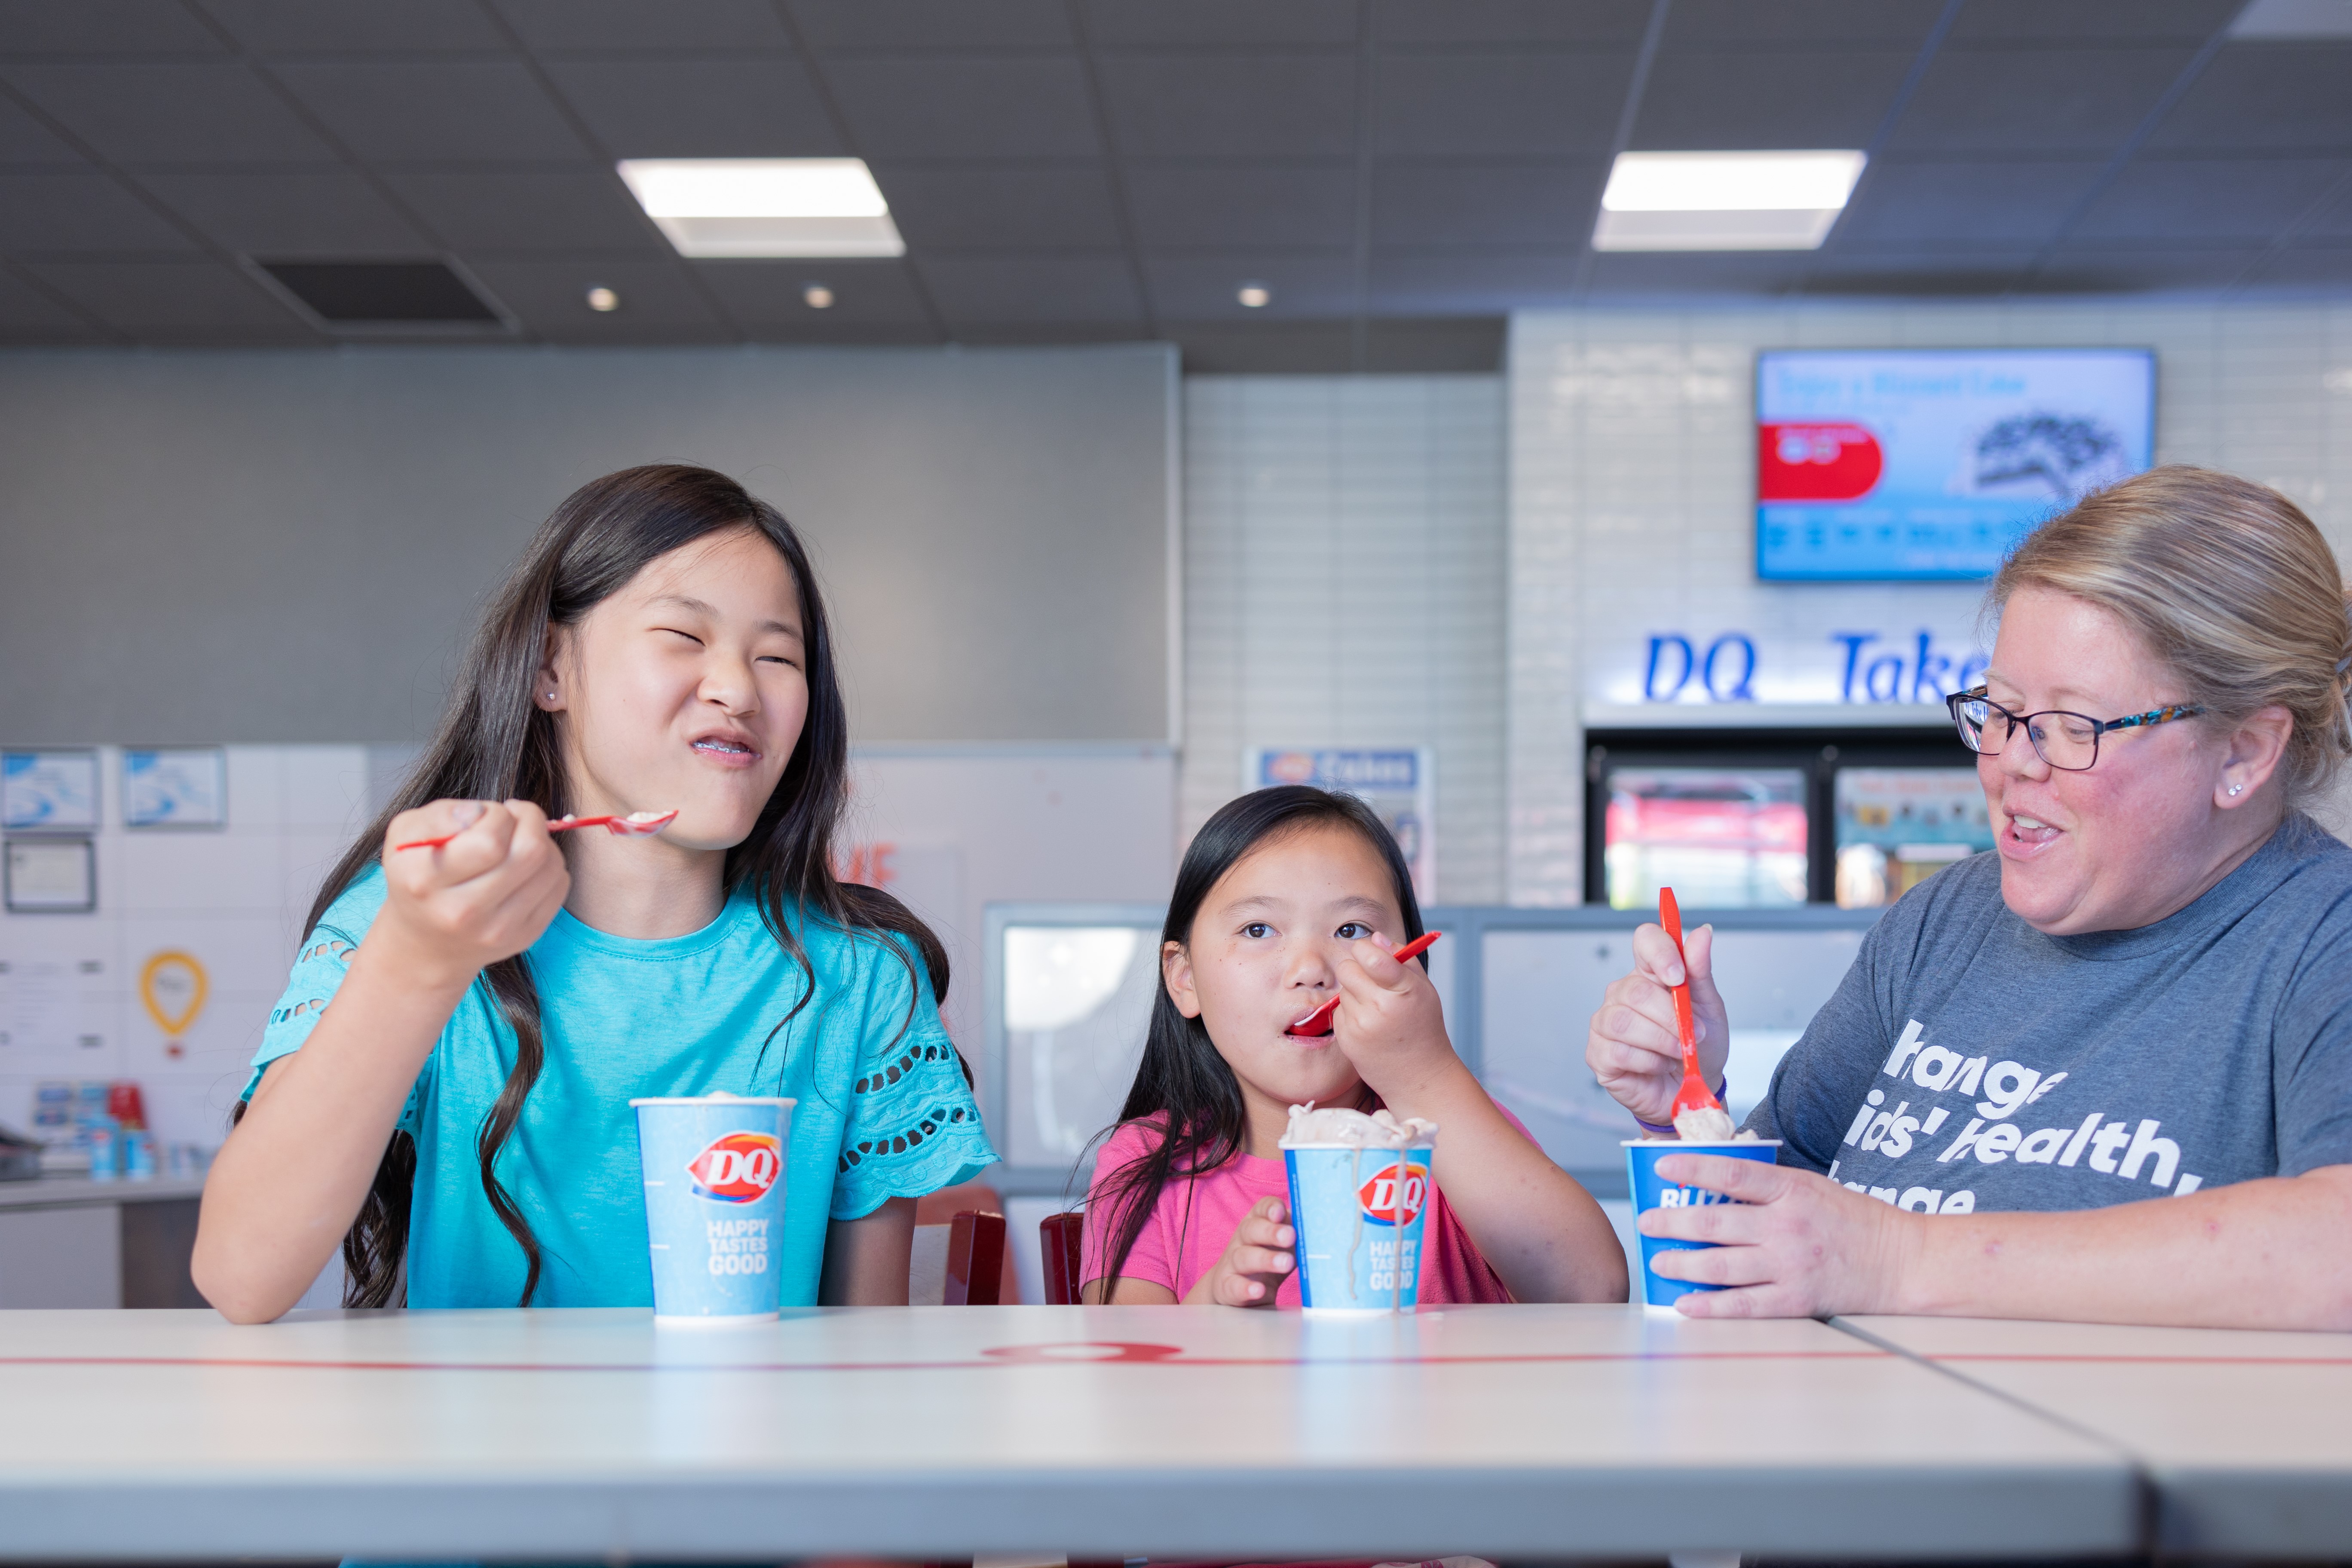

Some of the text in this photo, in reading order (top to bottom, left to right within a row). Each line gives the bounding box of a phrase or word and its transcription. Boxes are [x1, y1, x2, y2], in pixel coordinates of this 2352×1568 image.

[1645, 633, 1990, 701] DQ Take
[1883, 1018, 2069, 1120] hange
[1844, 1090, 1950, 1158] ids'
[705, 1148, 773, 1189] DQ
[1369, 1177, 1423, 1214] DQ
[707, 1219, 769, 1237] HAPPY
[708, 1237, 768, 1253] TASTES
[708, 1253, 768, 1275] GOOD
[1369, 1256, 1415, 1270] TASES
